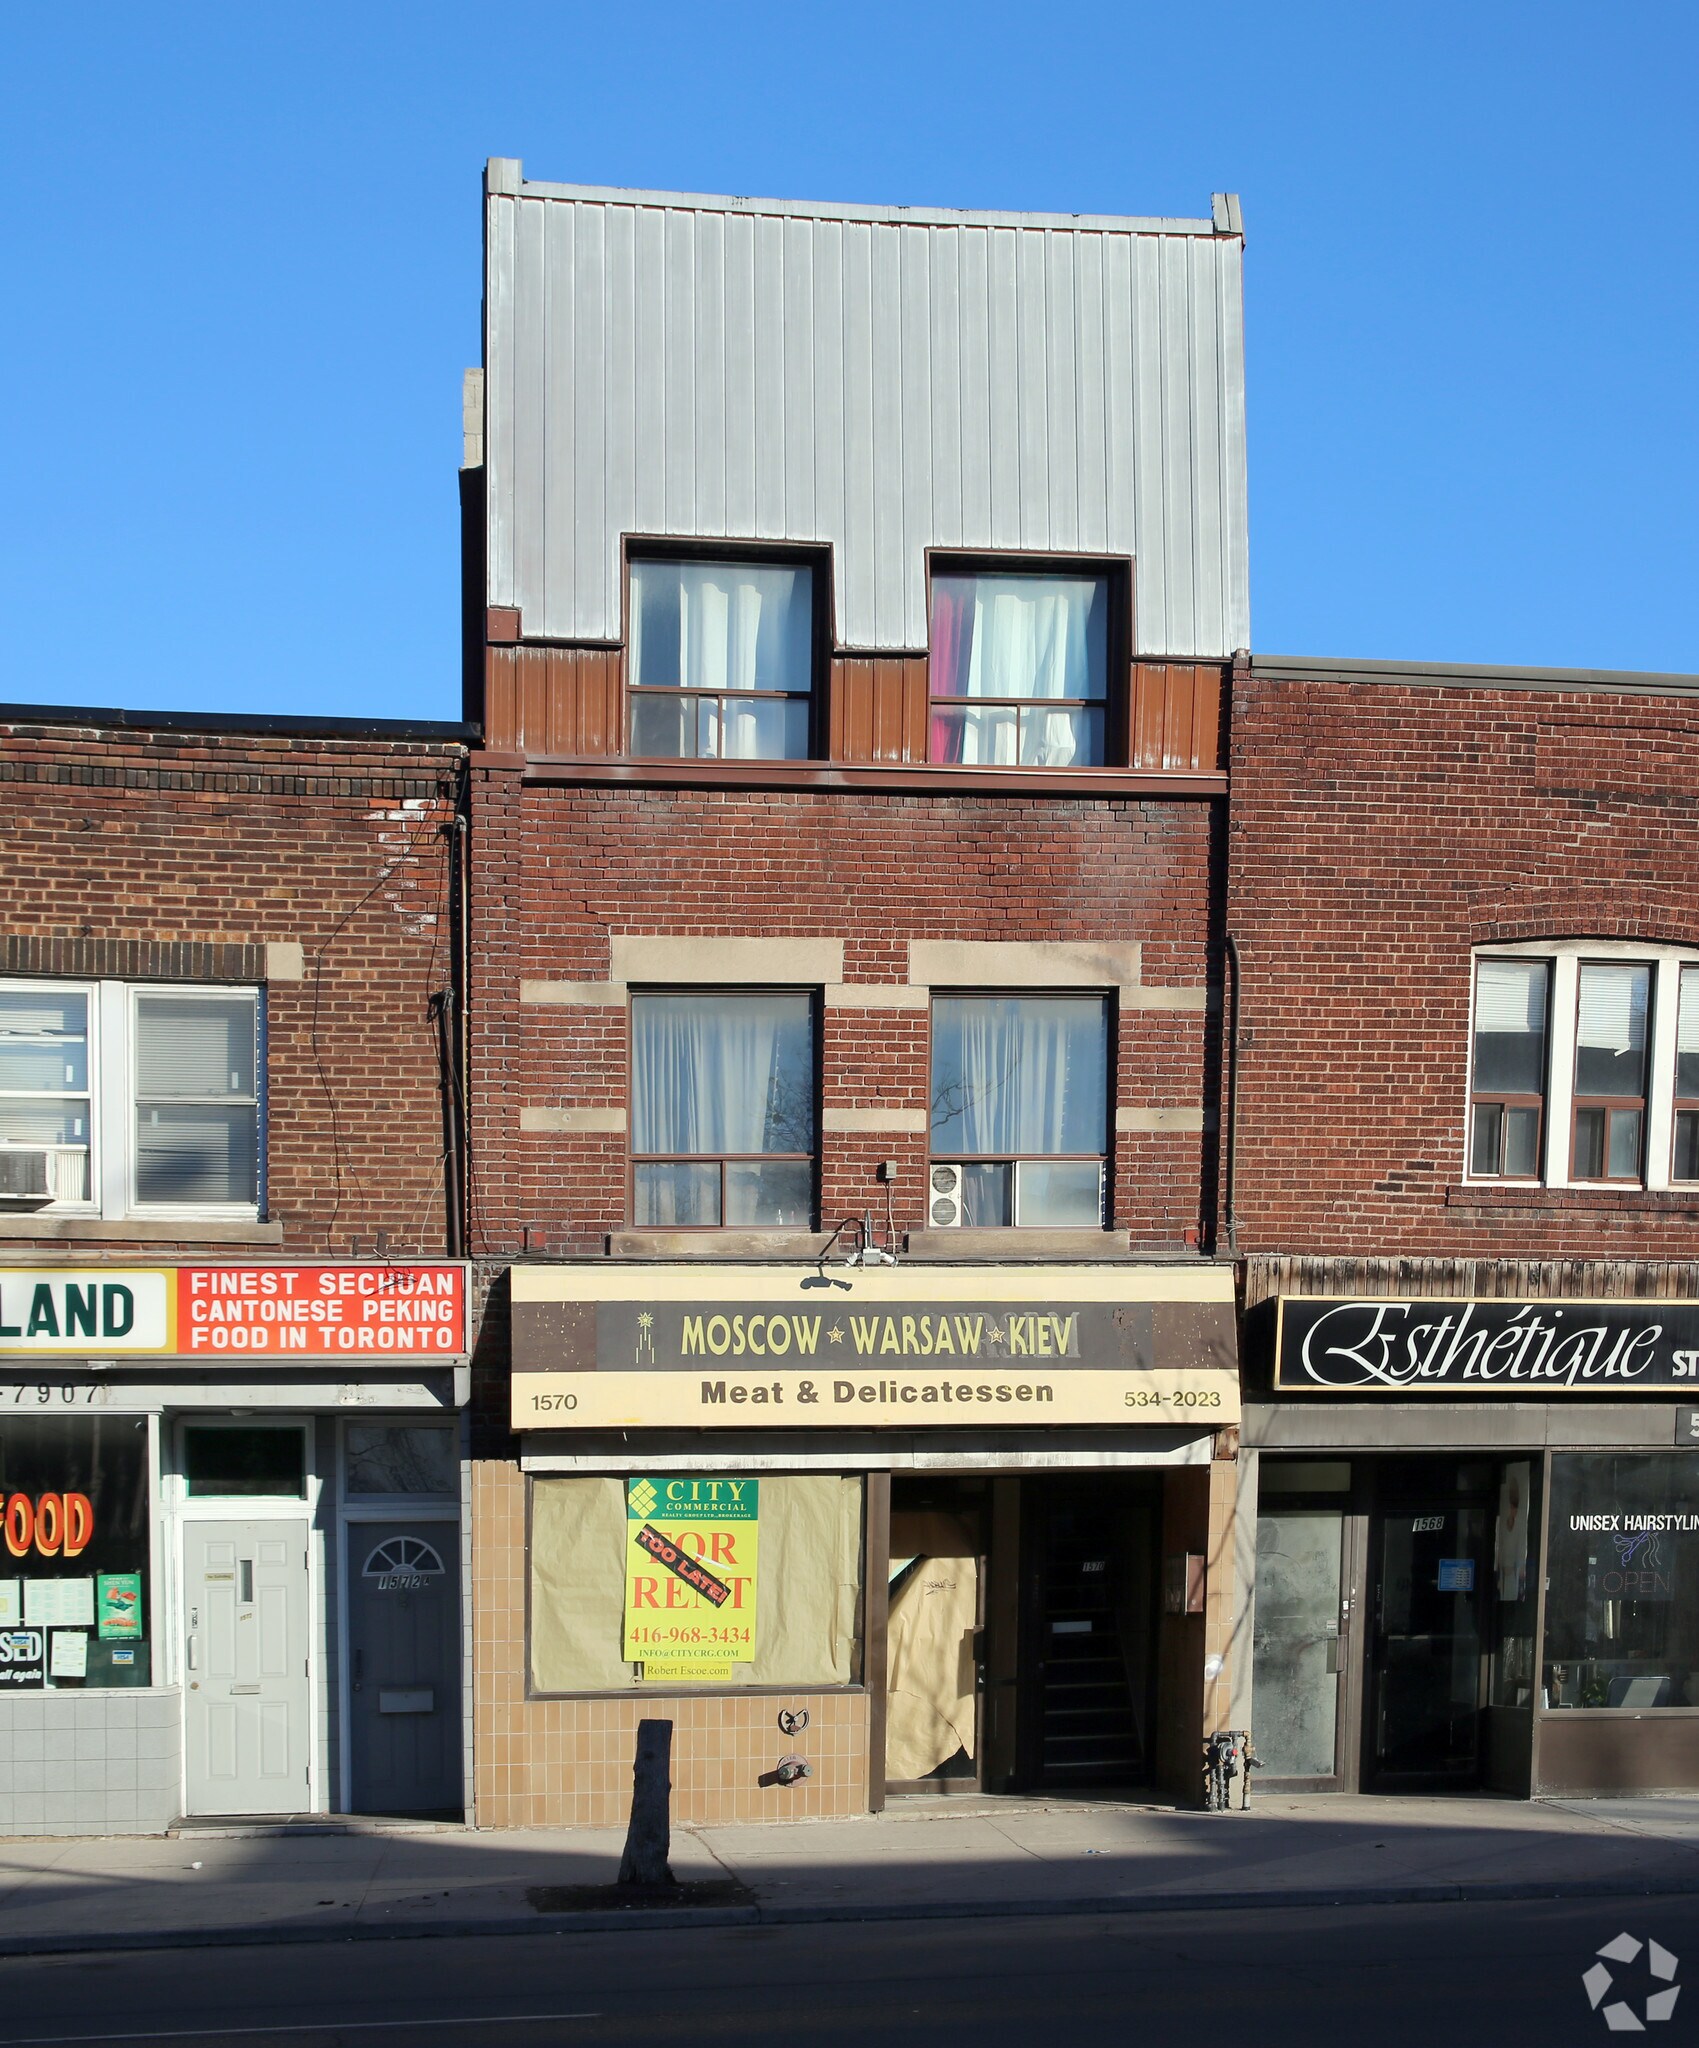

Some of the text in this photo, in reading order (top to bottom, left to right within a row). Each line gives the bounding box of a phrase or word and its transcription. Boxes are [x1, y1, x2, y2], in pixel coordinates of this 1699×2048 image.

[191, 1272, 453, 1295] FINEST SECHUAN
[191, 1299, 453, 1322] CANTONESE PEKING
[191, 1326, 453, 1349] FOOD IN TORONTO
[681, 1314, 822, 1356] MOSCOW
[849, 1314, 984, 1356] WARSAW
[1009, 1315, 1073, 1355] KIEV
[1302, 1301, 1663, 1386] Esthétique
[531, 1393, 578, 1411] 1570
[701, 1380, 1054, 1404] Meat & Delicatessen
[1124, 1391, 1221, 1408] 534-2023
[666, 1481, 746, 1501] CITY
[666, 1503, 747, 1511] COMMERCIAL
[0, 1492, 94, 1557] OOD
[1414, 1516, 1444, 1531] 1568
[1570, 1515, 1619, 1531] UNISEX
[640, 1528, 677, 1562] TOO
[1603, 1571, 1670, 1593] OPEN
[630, 1627, 750, 1643] 416-968-3434
[639, 1650, 739, 1658] INFO@CITYCRG.COM
[12, 1668, 42, 1683] again
[647, 1666, 729, 1675] Robert Escoe.com
